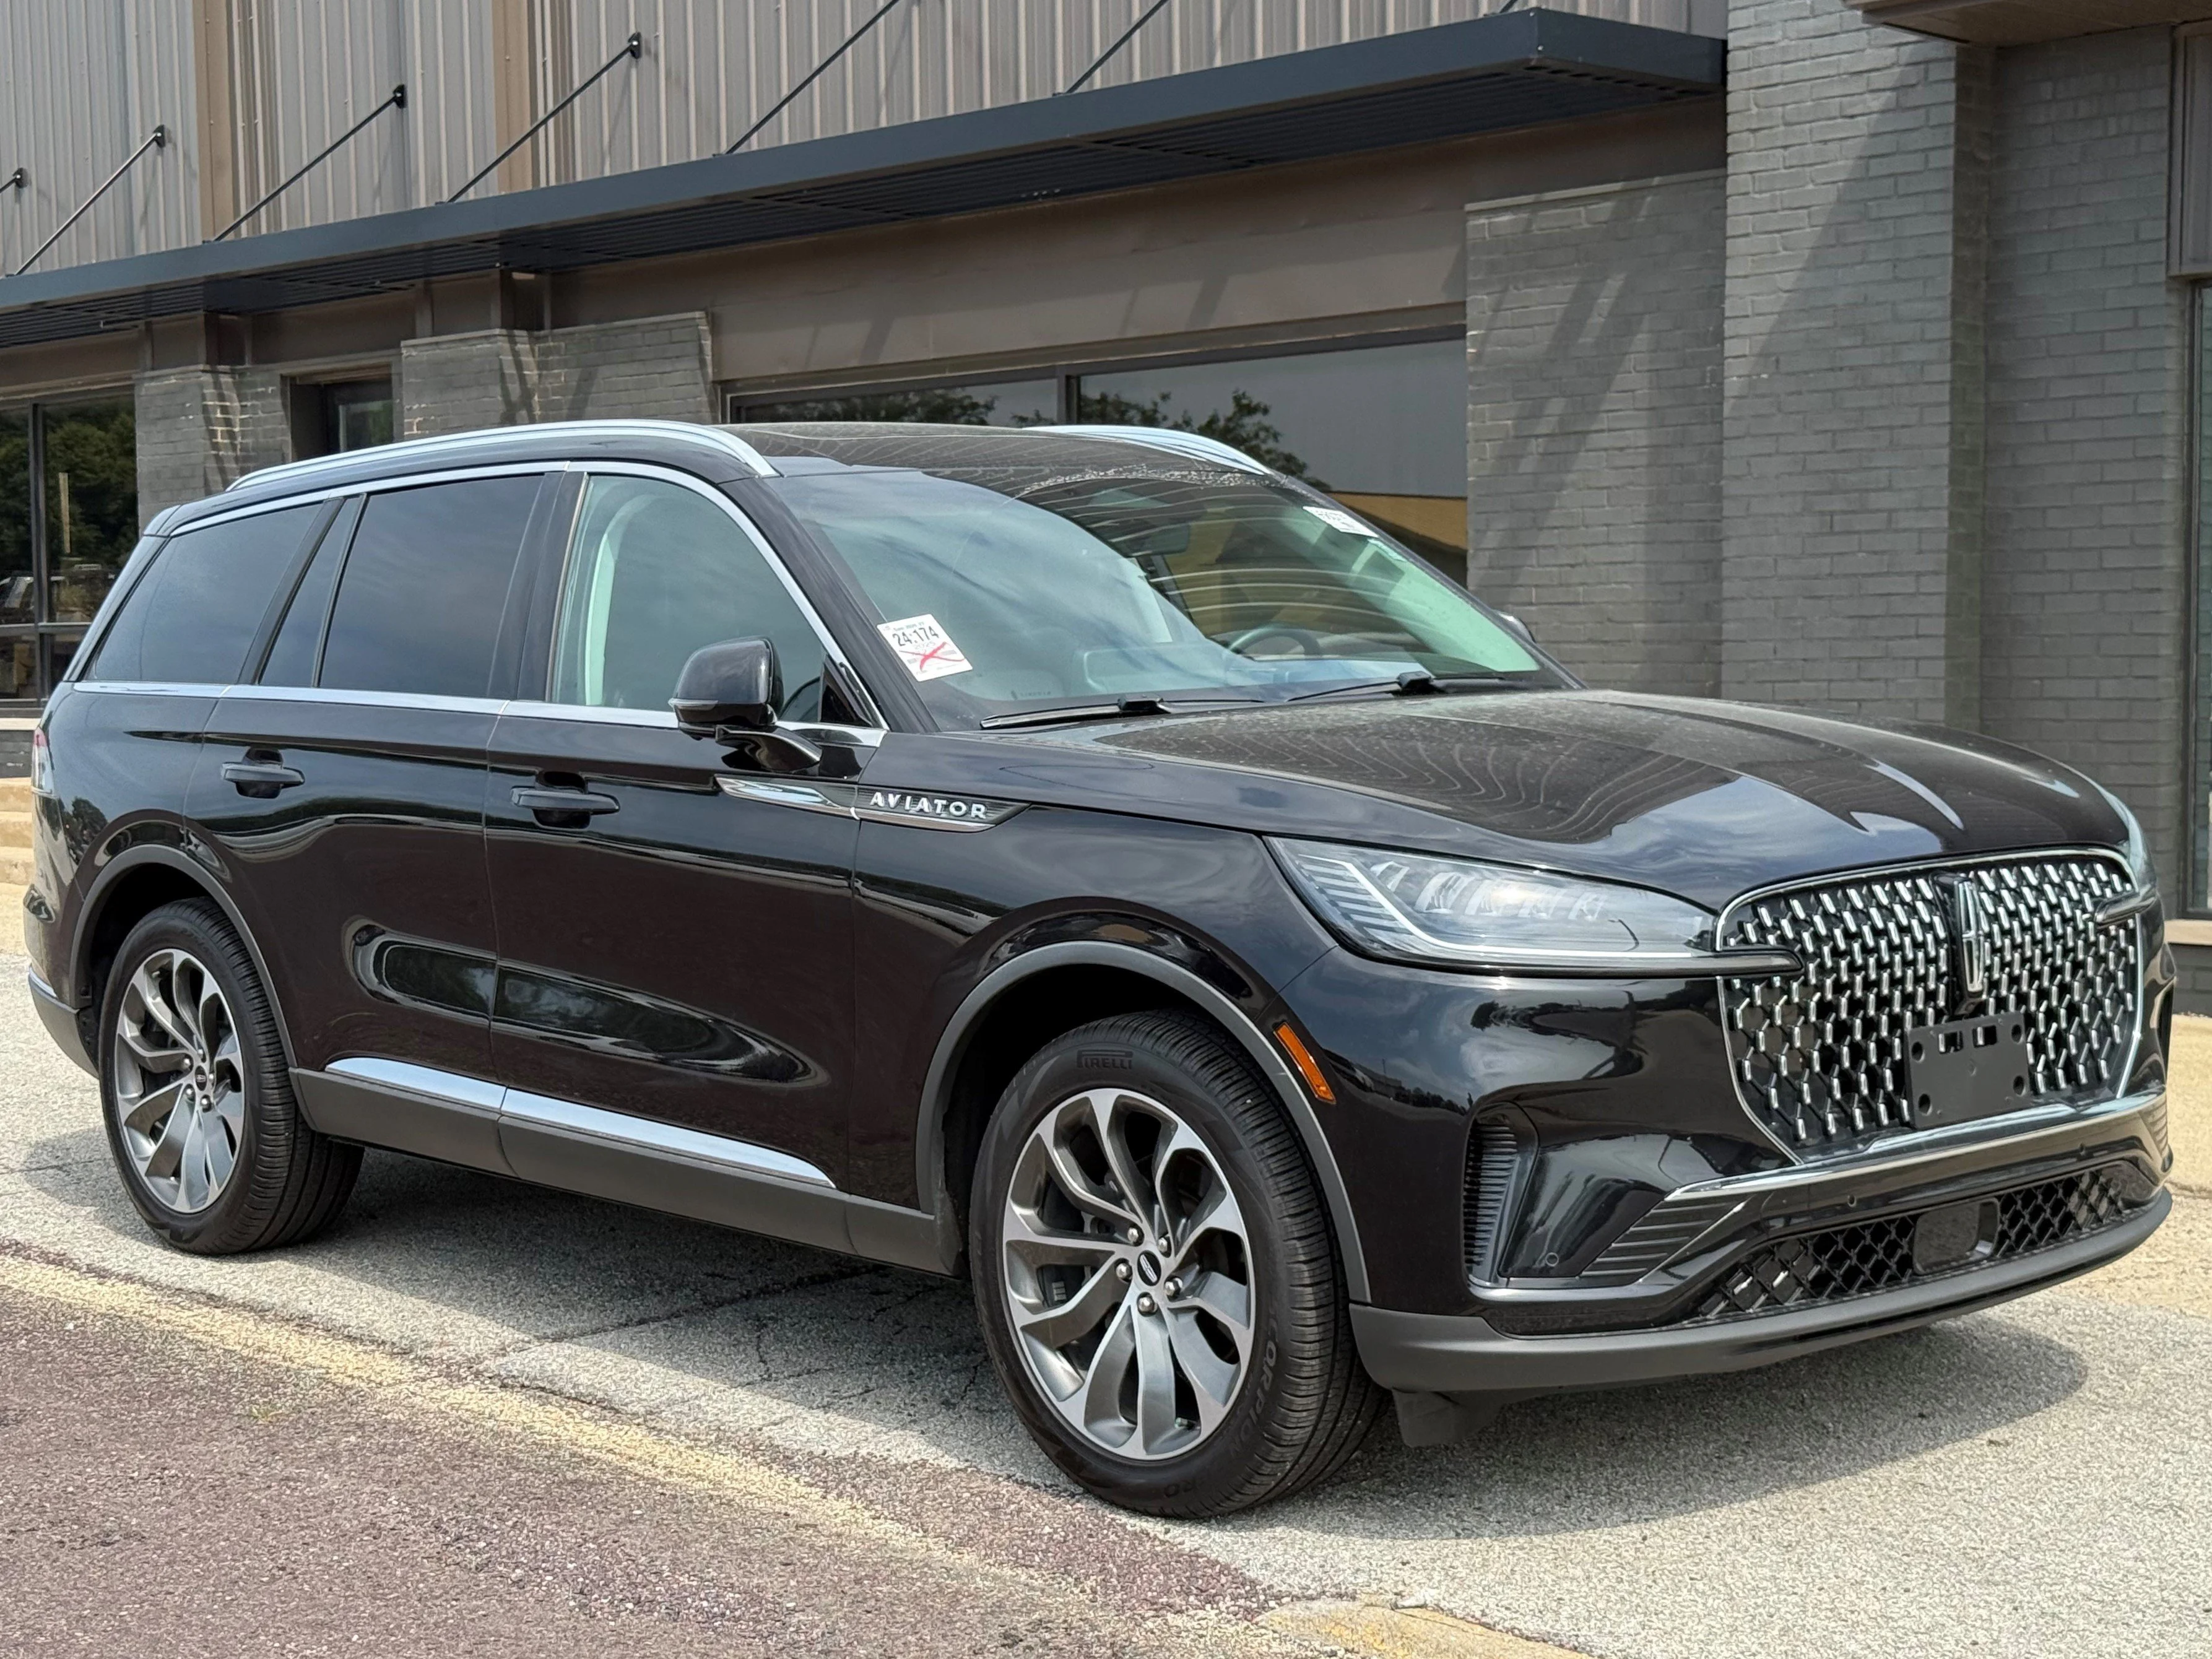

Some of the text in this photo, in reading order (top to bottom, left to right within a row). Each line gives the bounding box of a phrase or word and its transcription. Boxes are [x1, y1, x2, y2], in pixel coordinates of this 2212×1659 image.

[892, 625, 939, 647] 24:174
[870, 792, 986, 820] AVIATOR
[1077, 1049, 1134, 1070] PIRELLI
